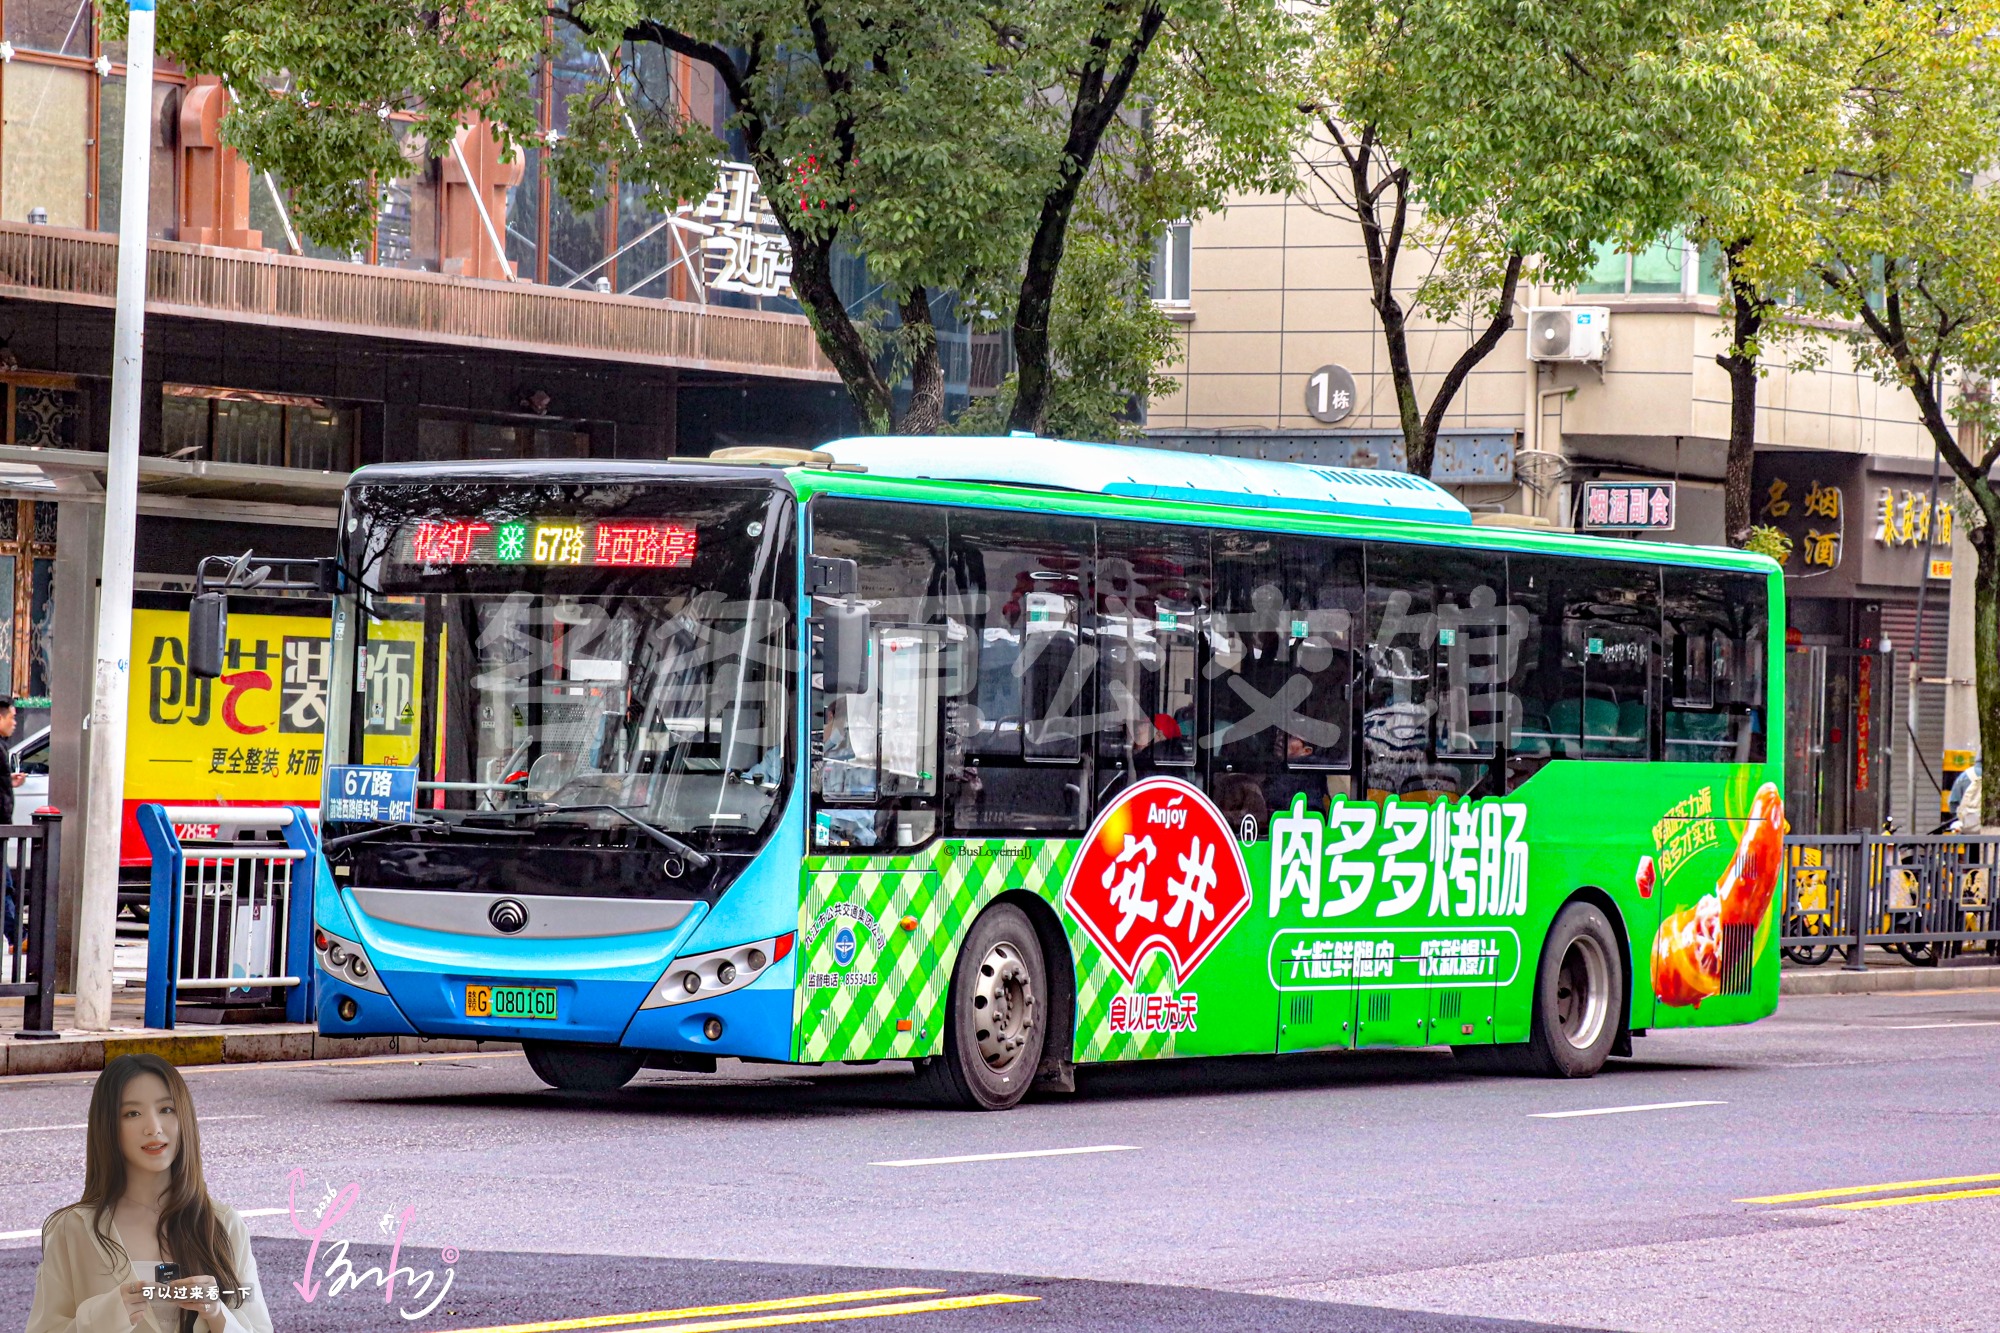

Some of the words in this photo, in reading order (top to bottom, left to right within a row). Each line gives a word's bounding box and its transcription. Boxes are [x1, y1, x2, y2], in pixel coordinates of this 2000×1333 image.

[1588, 486, 1670, 525] 烟酒副食
[414, 523, 490, 563] 化纤厂
[534, 524, 585, 564] 67路
[344, 770, 393, 797] 67路
[1147, 795, 1188, 829] Anjoy
[1268, 799, 1530, 919] 肉多多烤肠
[1102, 833, 1217, 943] 安井
[1290, 940, 1395, 979] 大粒鲜腿肉
[1399, 938, 1500, 977] 一咬就爆汁
[1110, 994, 1198, 1032] 食以民为天
